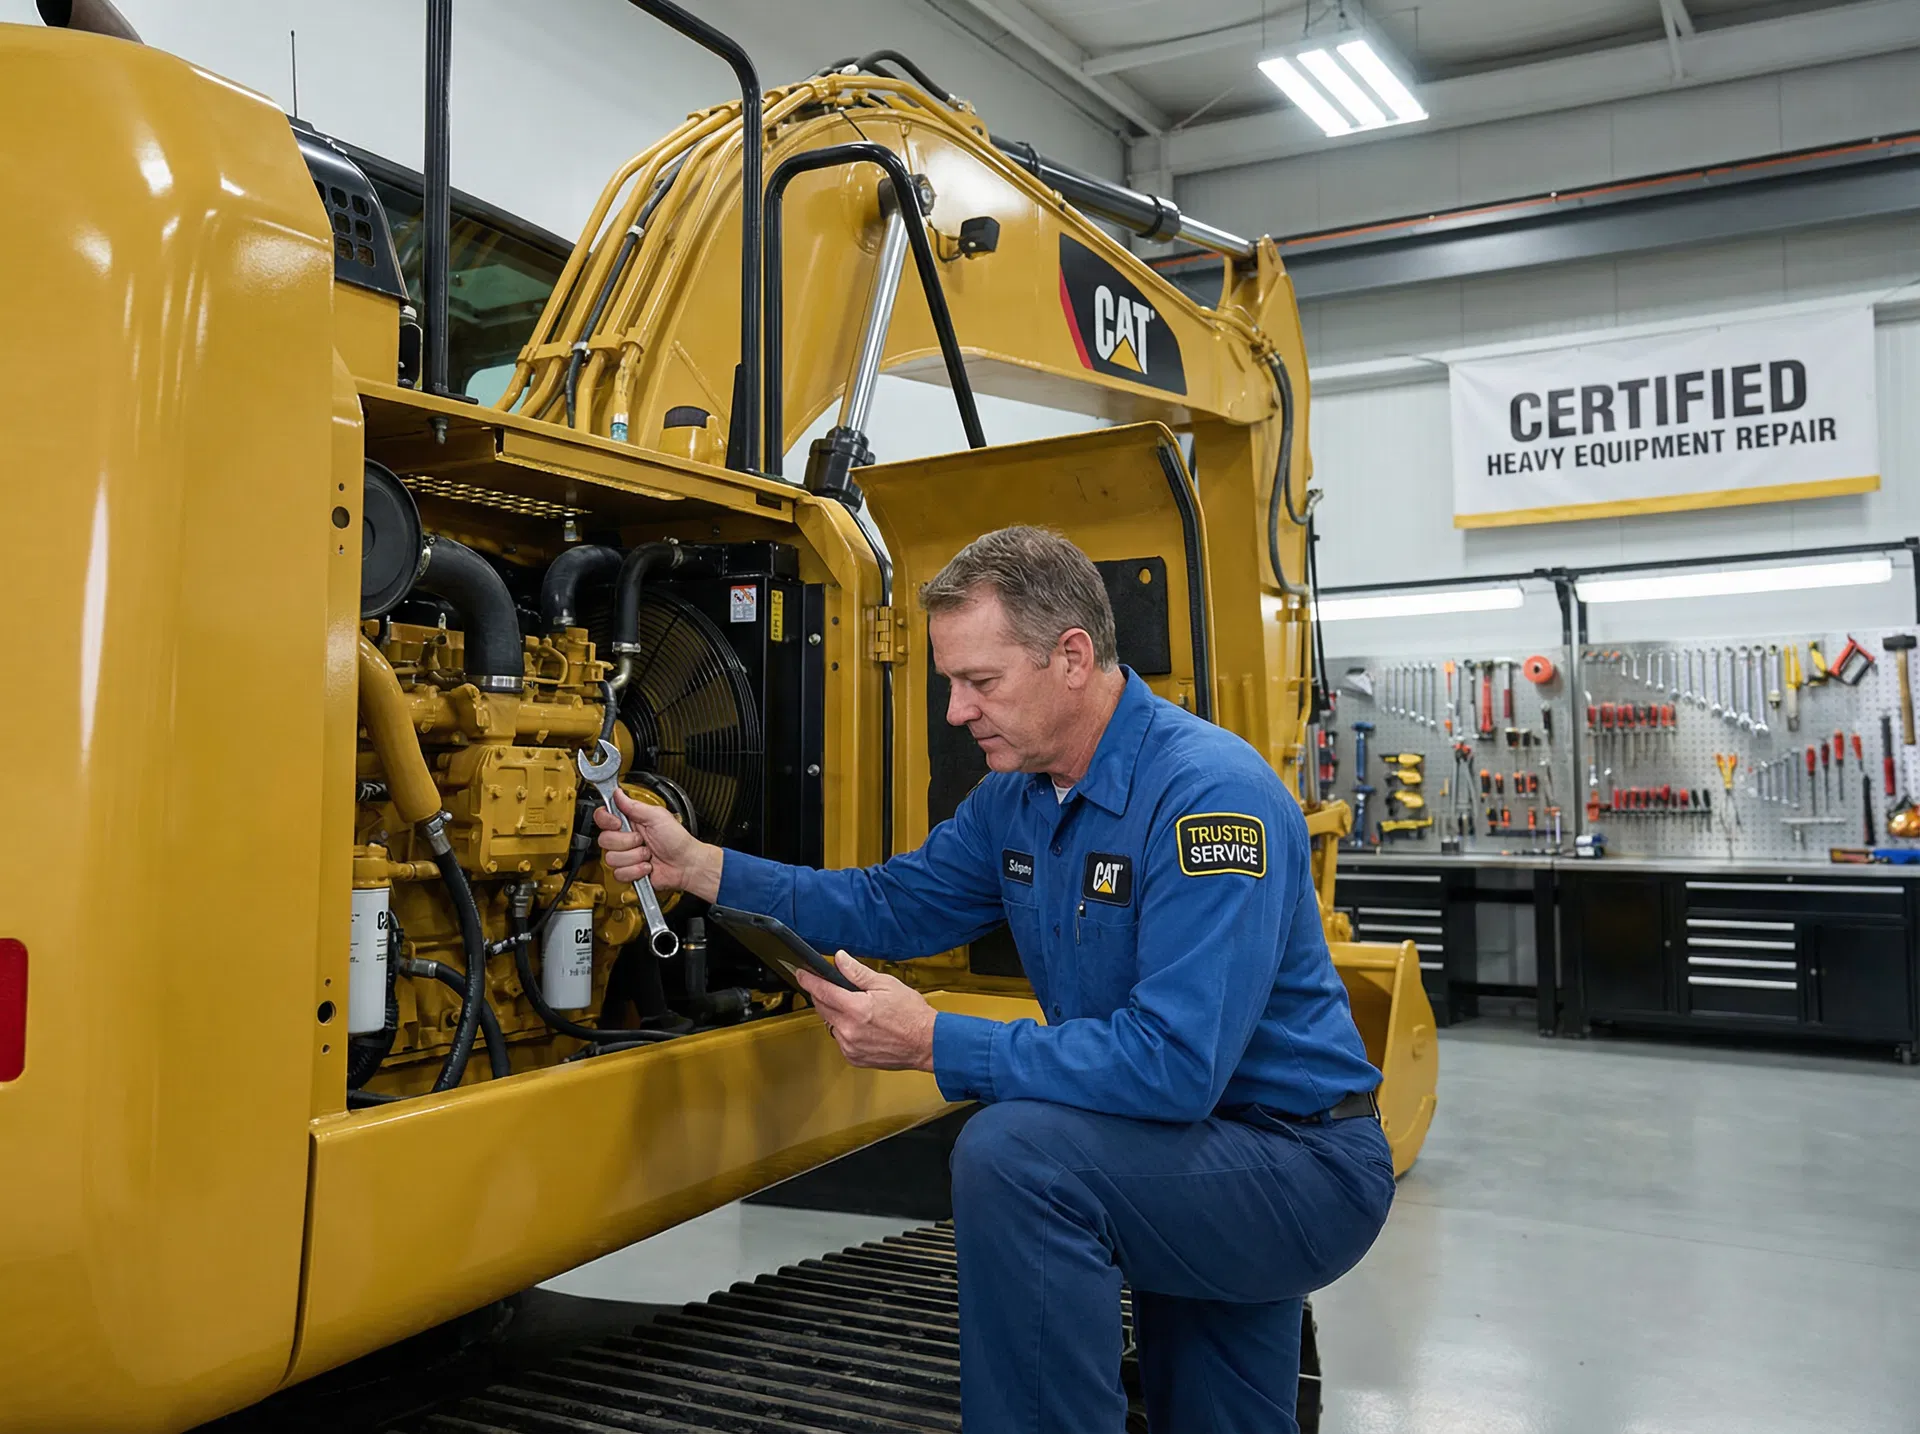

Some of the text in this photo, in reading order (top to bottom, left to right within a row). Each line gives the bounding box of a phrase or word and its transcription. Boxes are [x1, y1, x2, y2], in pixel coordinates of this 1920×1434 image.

[1094, 285, 1150, 375] CAT
[1510, 359, 1807, 443] CERTIFIED
[1487, 417, 1837, 477] HEAVY EQUIPMENT REPAIR
[1187, 825, 1258, 846] TRUSTED
[1190, 843, 1258, 866] SERVICE
[1092, 861, 1121, 894] CAT
